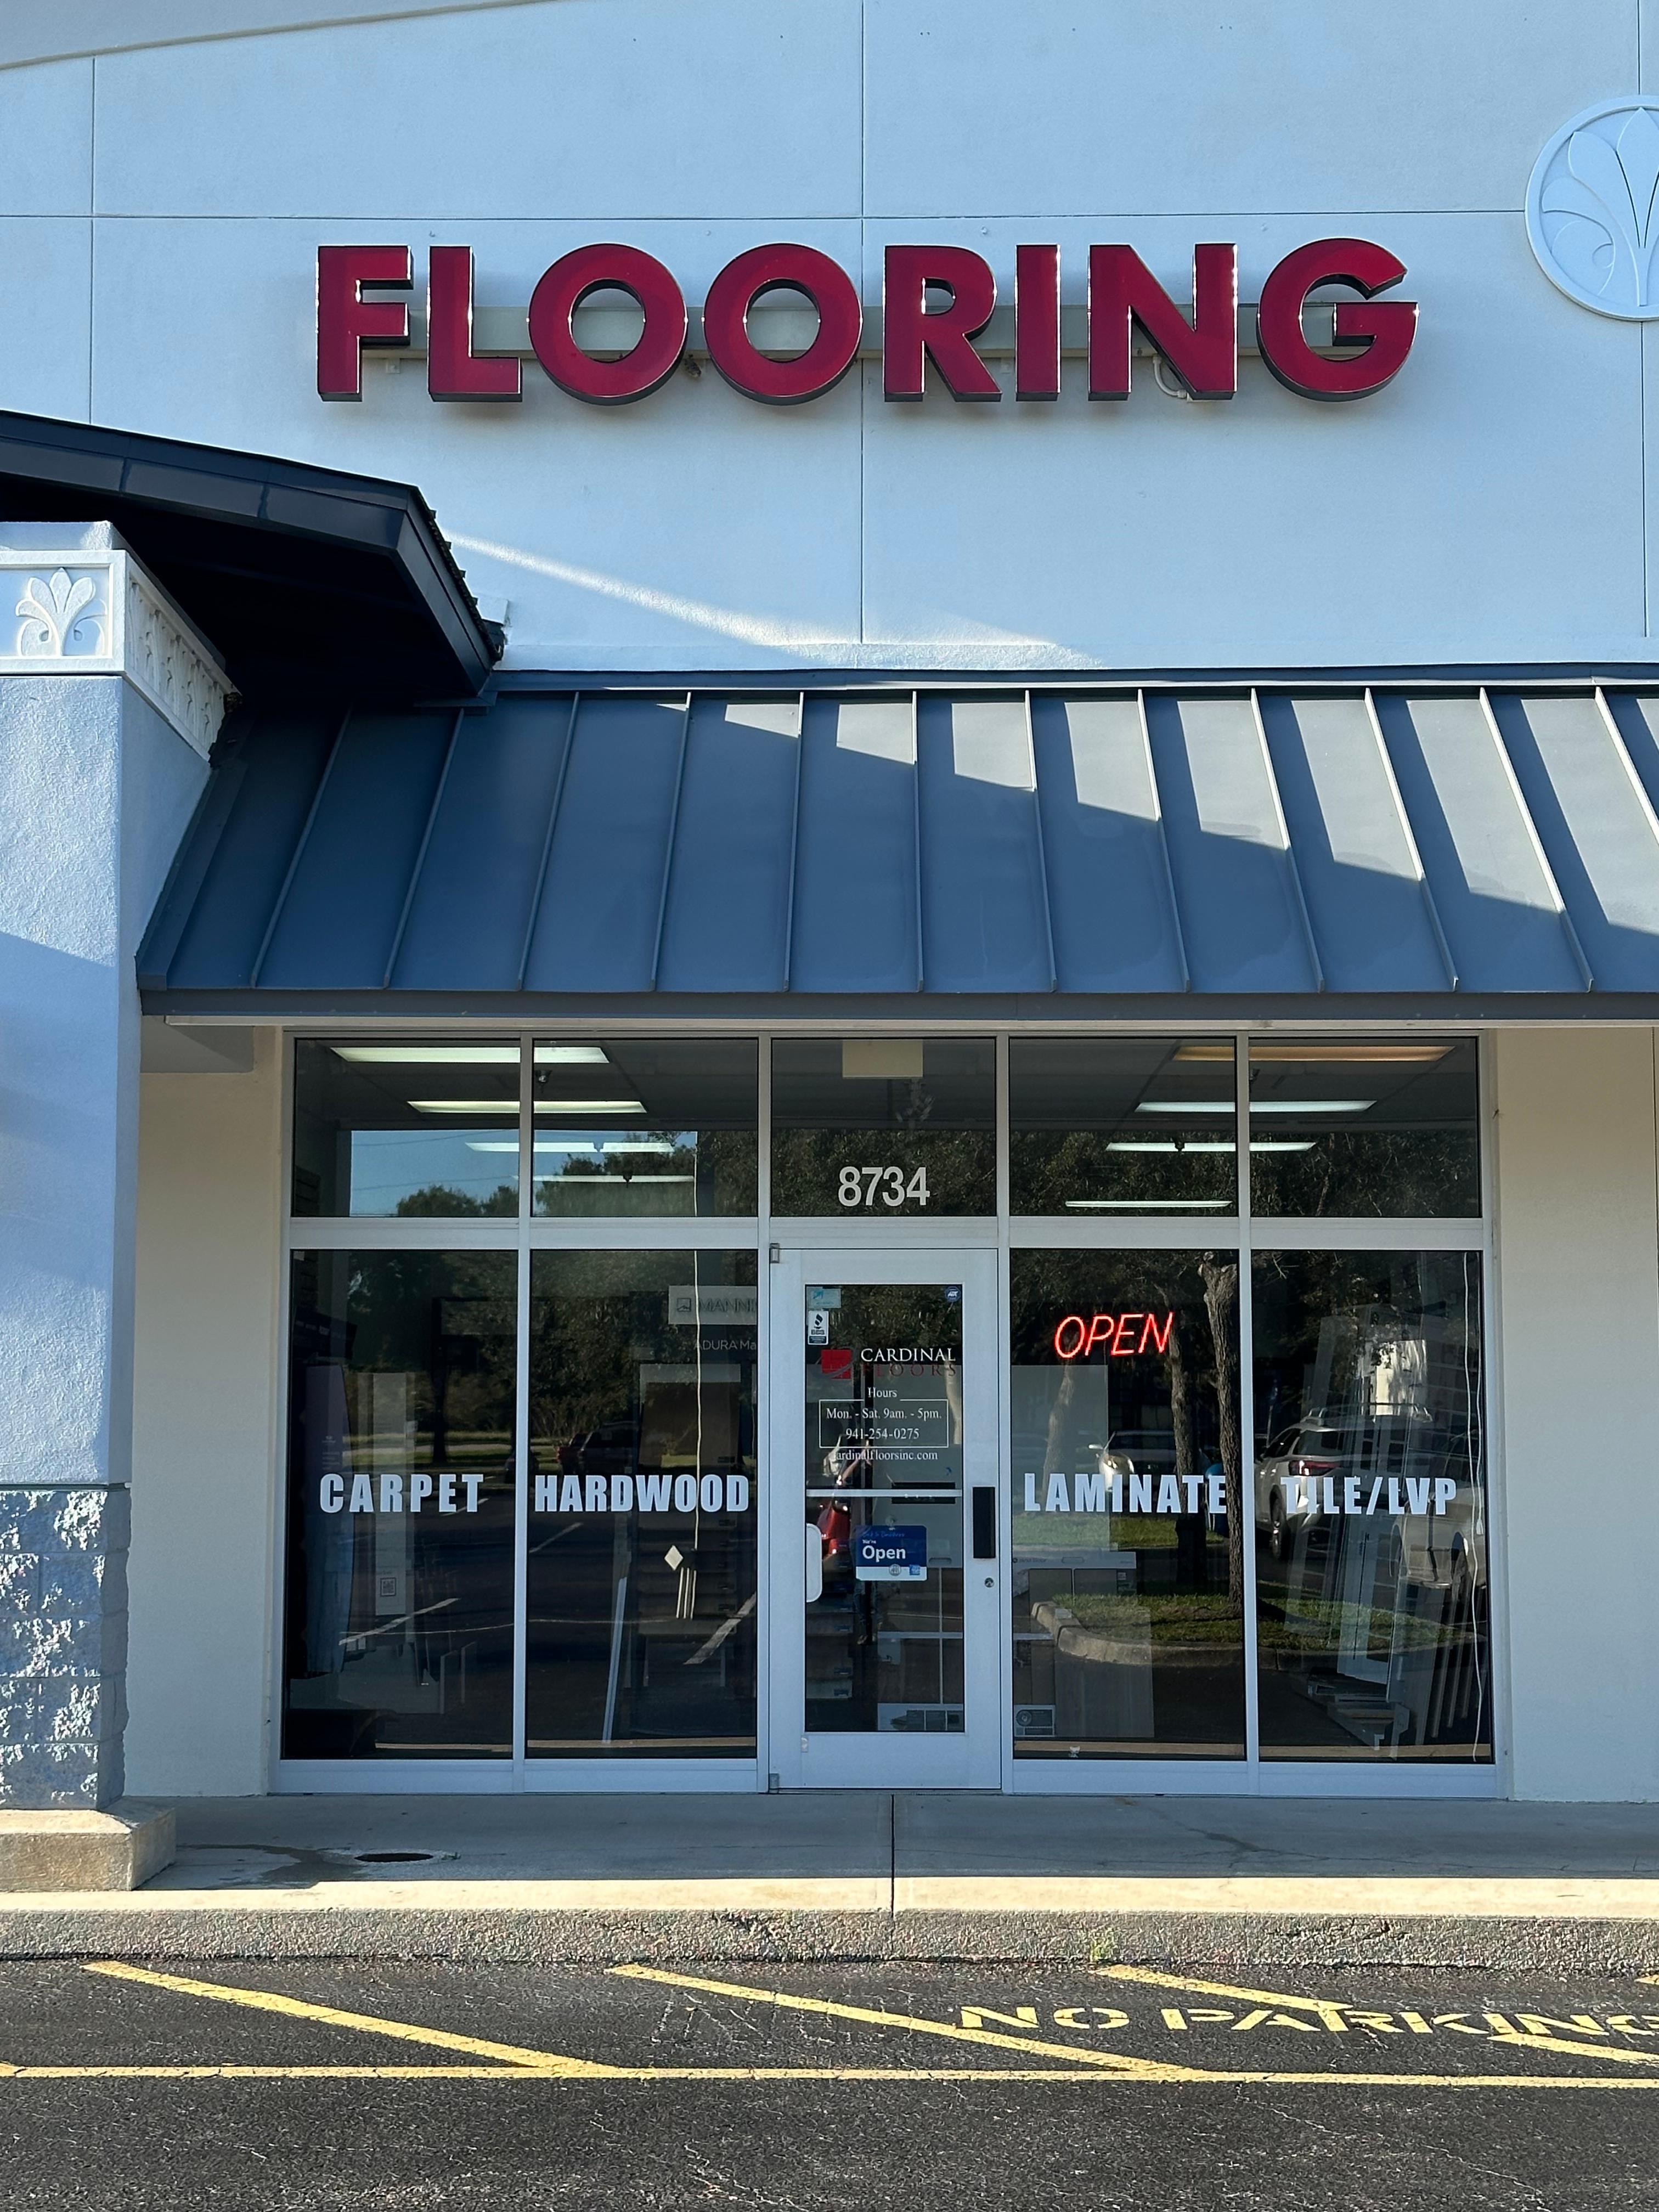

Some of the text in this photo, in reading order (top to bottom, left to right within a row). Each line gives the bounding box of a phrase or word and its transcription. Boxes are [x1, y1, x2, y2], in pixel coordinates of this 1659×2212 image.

[315, 238, 1420, 405] FLOORING
[838, 1166, 930, 1206] 8734
[693, 1340, 737, 1350] ADURA
[1054, 1311, 1175, 1358] OPEN
[861, 1348, 956, 1362] CARDINAL
[863, 1363, 956, 1377] FLOORS
[868, 1387, 898, 1398] Hours
[826, 1408, 852, 1419] Mon.
[862, 1408, 881, 1419] Sat.
[883, 1408, 907, 1419] 9am.
[917, 1408, 942, 1421] 5pm.
[846, 1428, 919, 1440] 941-254-0275
[833, 1449, 938, 1460] ardinalfloorsinc.com
[320, 1473, 484, 1513] CARPET
[535, 1474, 749, 1513] HARDWOOD
[1024, 1472, 1227, 1514] LAMINATE
[1280, 1476, 1457, 1515] TILE/LVP
[862, 1545, 906, 1562] Open
[960, 2005, 1659, 2036] NO PARKING
